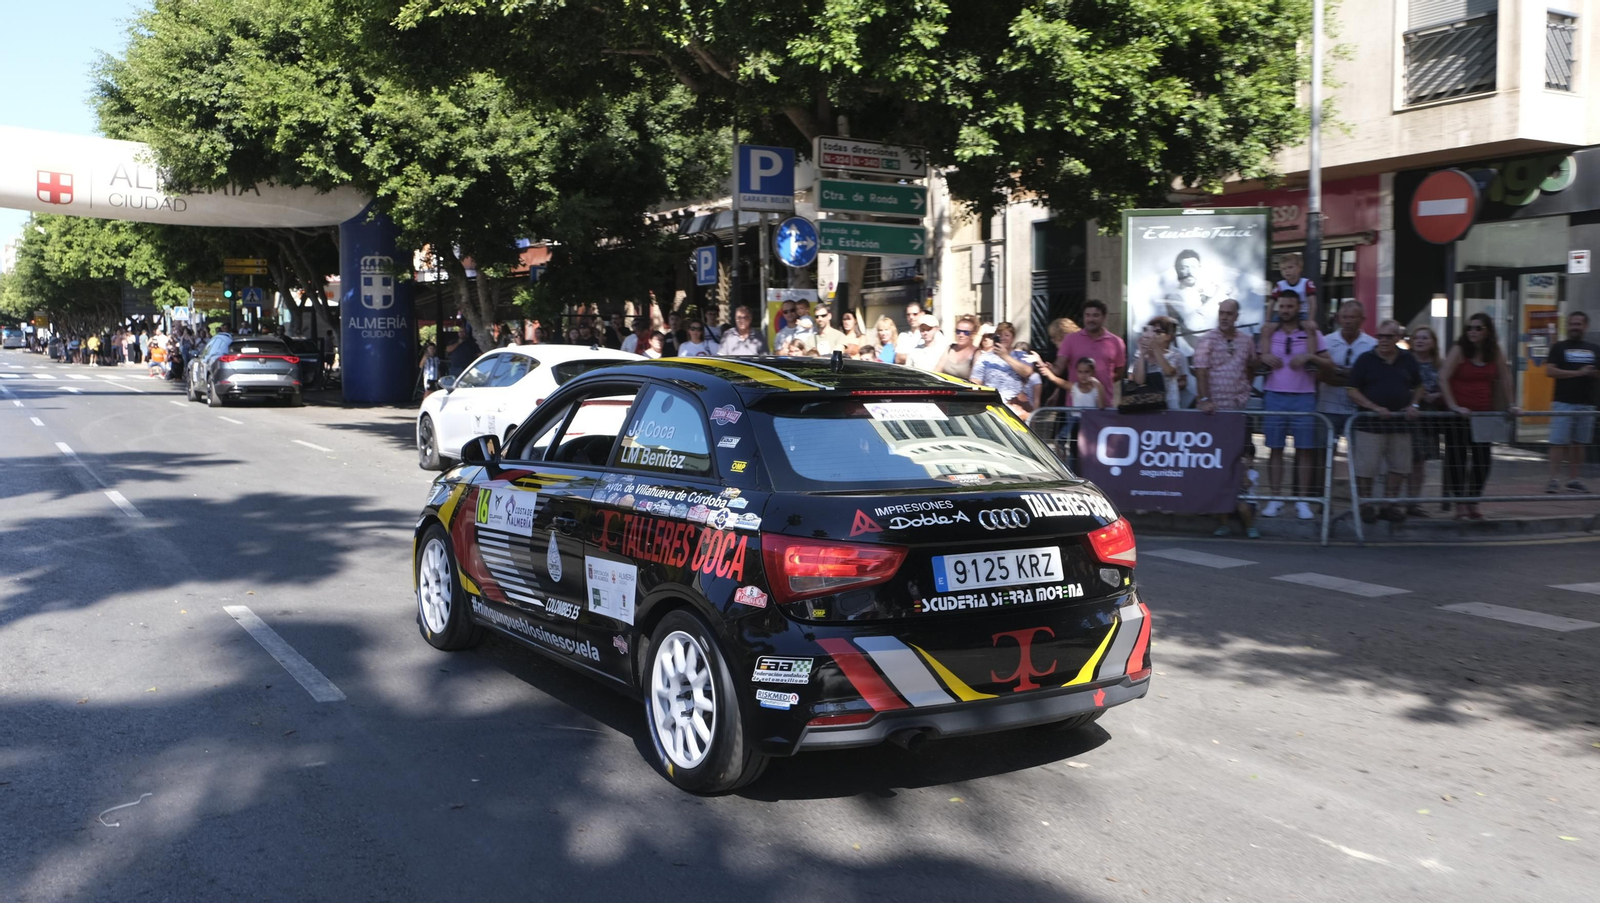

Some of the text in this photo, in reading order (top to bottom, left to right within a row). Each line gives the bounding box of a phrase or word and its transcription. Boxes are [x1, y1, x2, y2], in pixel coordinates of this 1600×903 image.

[823, 141, 899, 157] todas direcciones
[750, 149, 783, 190] P
[108, 192, 188, 213] CIUDAD
[742, 195, 768, 203] GARAJE
[822, 189, 898, 204] Ctra. de Ronda
[822, 227, 848, 235] avenida
[821, 236, 880, 249] La Estación
[701, 250, 713, 280] P
[348, 315, 408, 329] ALMERÍA
[361, 330, 395, 339] CIUDAD
[645, 420, 676, 439] Coca
[1140, 430, 1213, 451] grupo
[620, 446, 686, 469] LM Benítez
[731, 462, 747, 471] OMP
[1140, 448, 1223, 469] control
[1139, 469, 1184, 478] seguridad
[604, 482, 623, 493] Ayto.
[624, 483, 635, 494] de
[635, 484, 676, 499] Villanueva
[675, 490, 687, 501] de
[687, 491, 727, 508] Córdoba
[477, 488, 492, 524] 16
[874, 499, 954, 517] IMPRESIONES
[1020, 493, 1091, 518] TALLERES
[621, 514, 748, 582] TALLERES COCA
[954, 553, 1055, 584] 9125 KRZ
[938, 577, 944, 585] E
[749, 586, 755, 596] 6
[471, 596, 601, 662] #ningunpueblosinescuela
